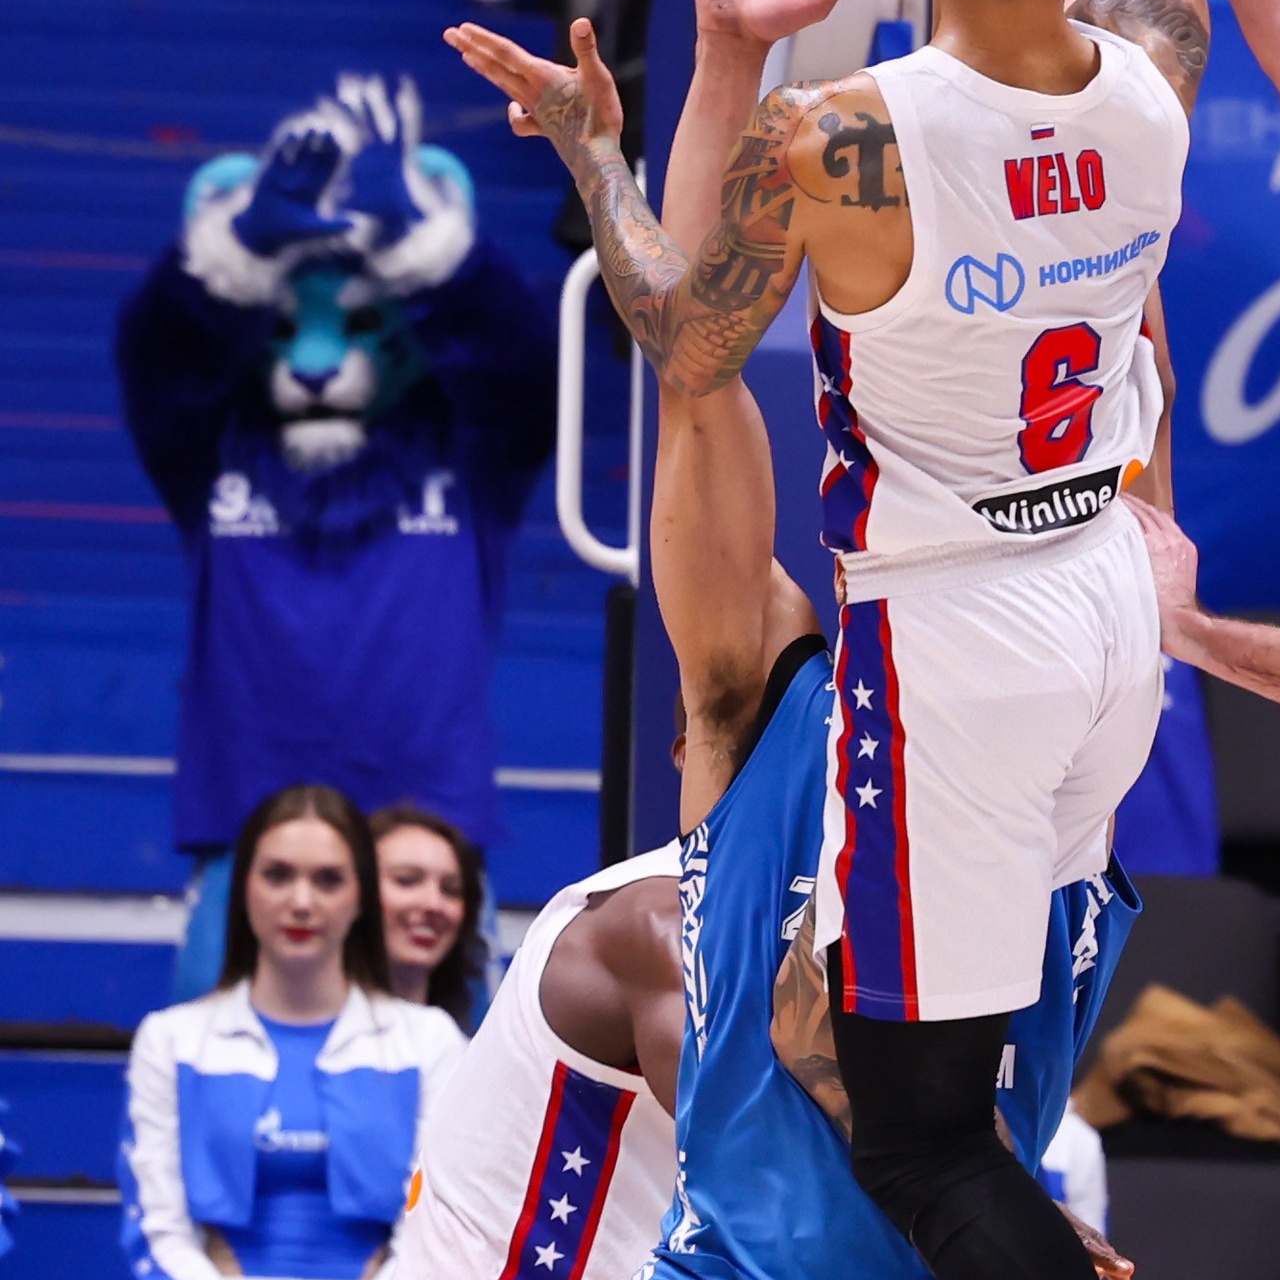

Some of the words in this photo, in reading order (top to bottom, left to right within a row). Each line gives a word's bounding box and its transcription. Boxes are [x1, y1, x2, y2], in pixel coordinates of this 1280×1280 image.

[1004, 149, 1107, 221] MELO
[1038, 229, 1162, 288] НОРНИКЕЛЬ
[1016, 321, 1104, 475] 6
[980, 484, 1113, 531] Winline
